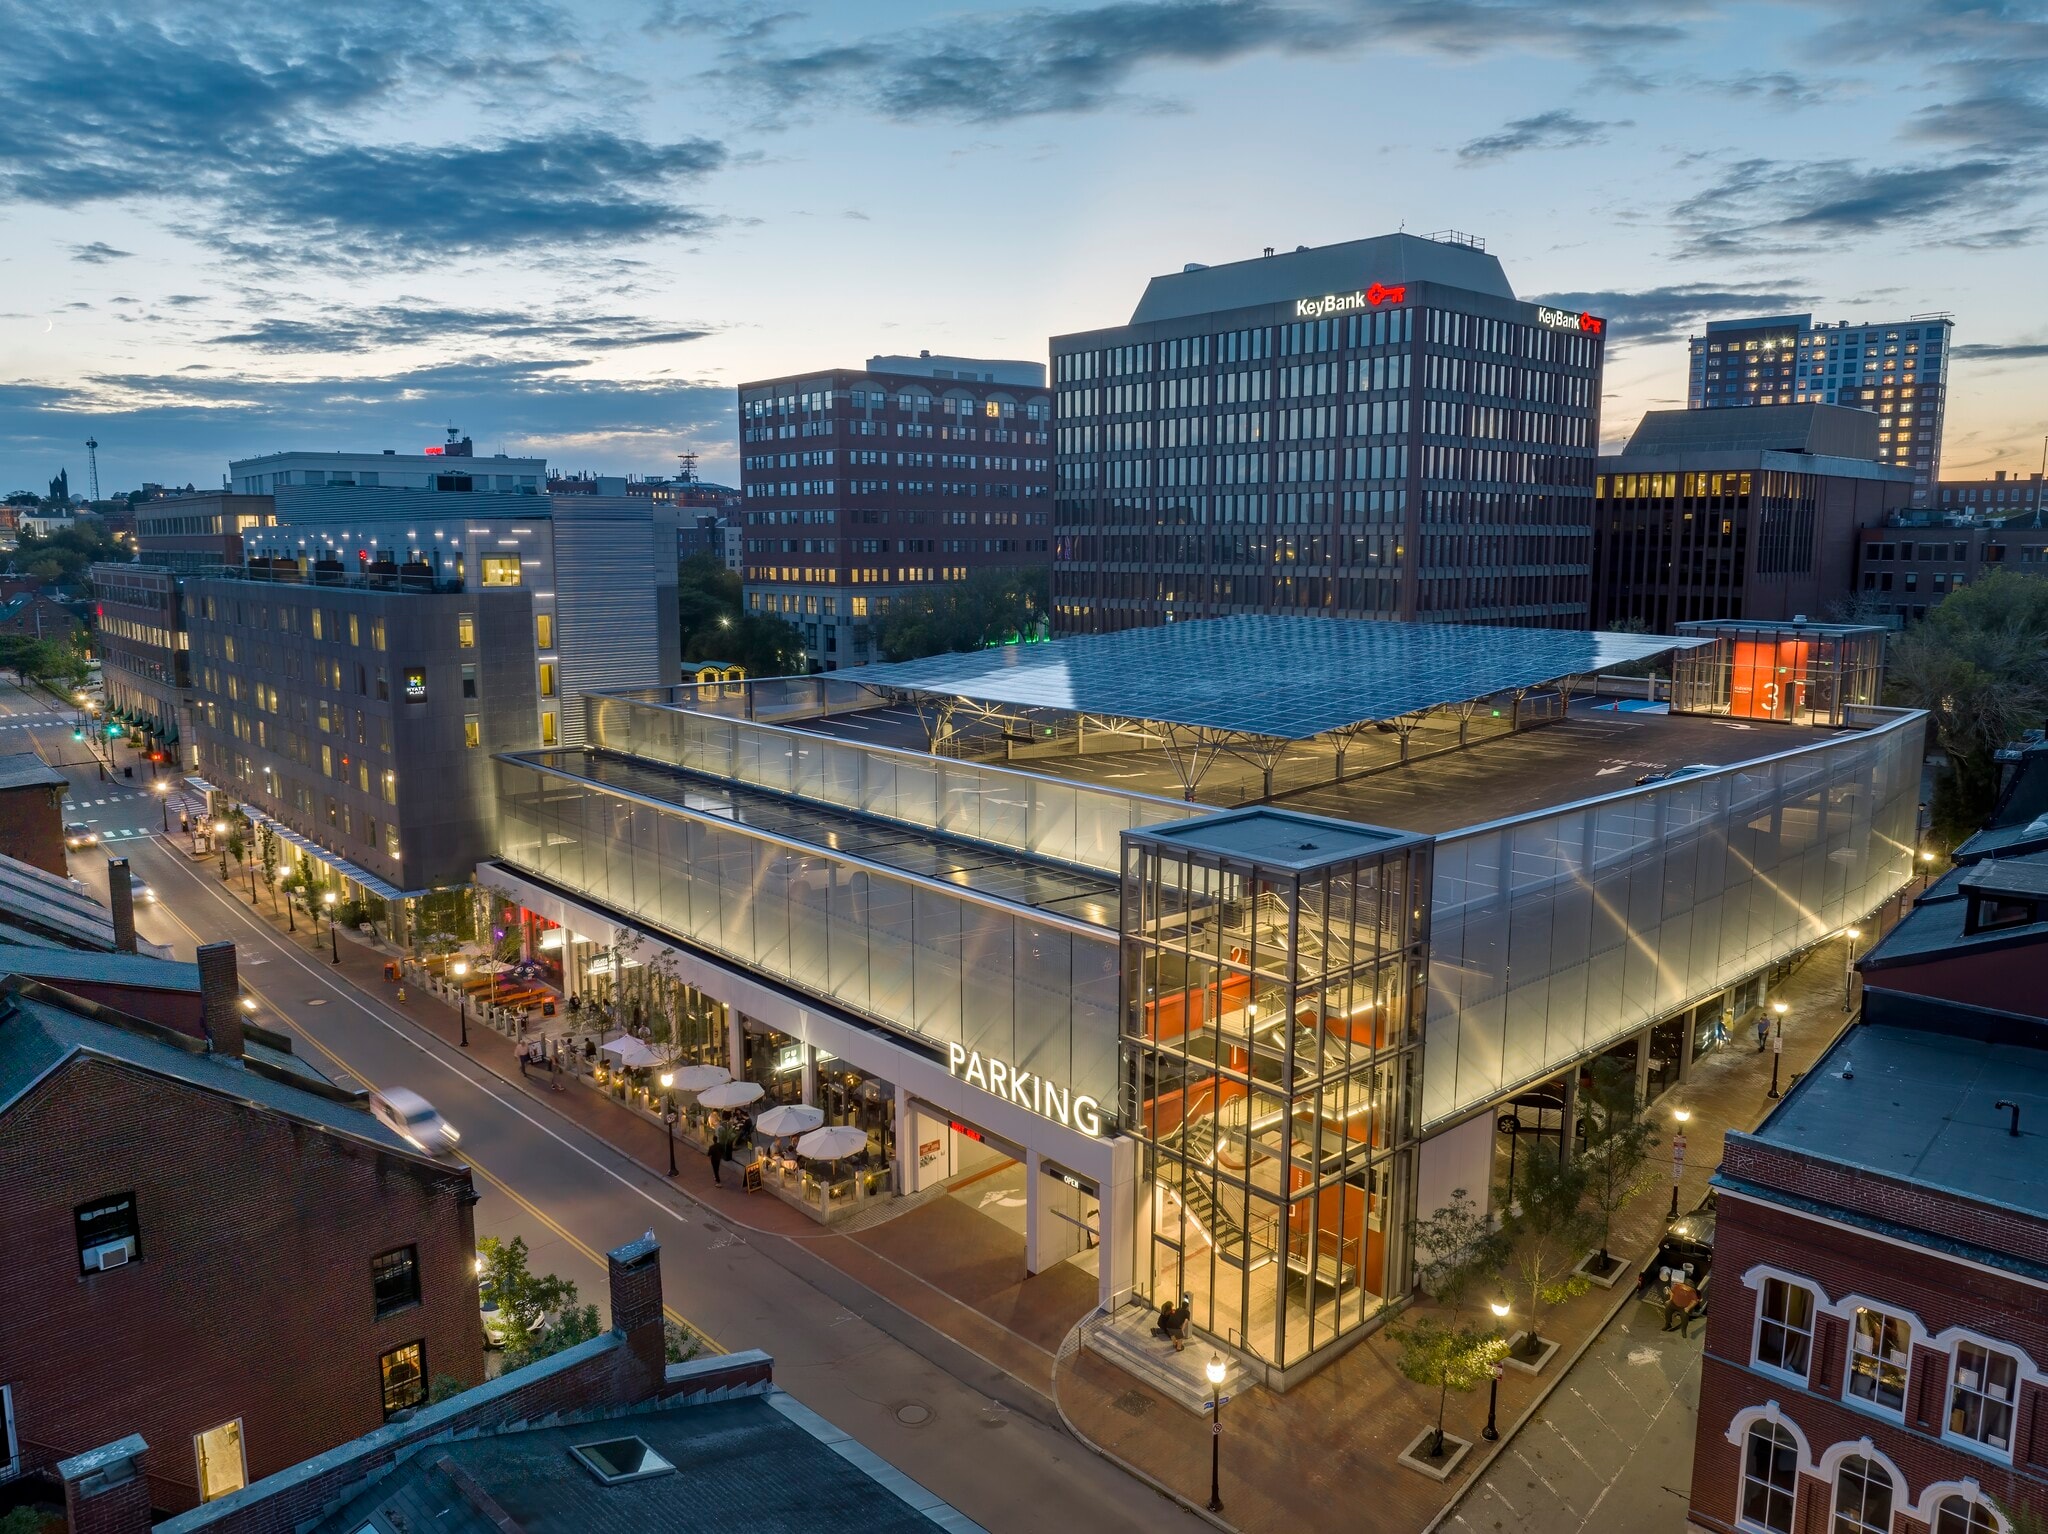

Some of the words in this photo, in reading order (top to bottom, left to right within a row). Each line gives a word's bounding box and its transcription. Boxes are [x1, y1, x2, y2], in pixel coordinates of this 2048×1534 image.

[1296, 291, 1366, 317] KeyBank
[1538, 306, 1581, 330] KeyBank
[1761, 682, 1779, 711] 3
[949, 1041, 1100, 1136] PARKING
[1063, 1175, 1079, 1189] OPEN
